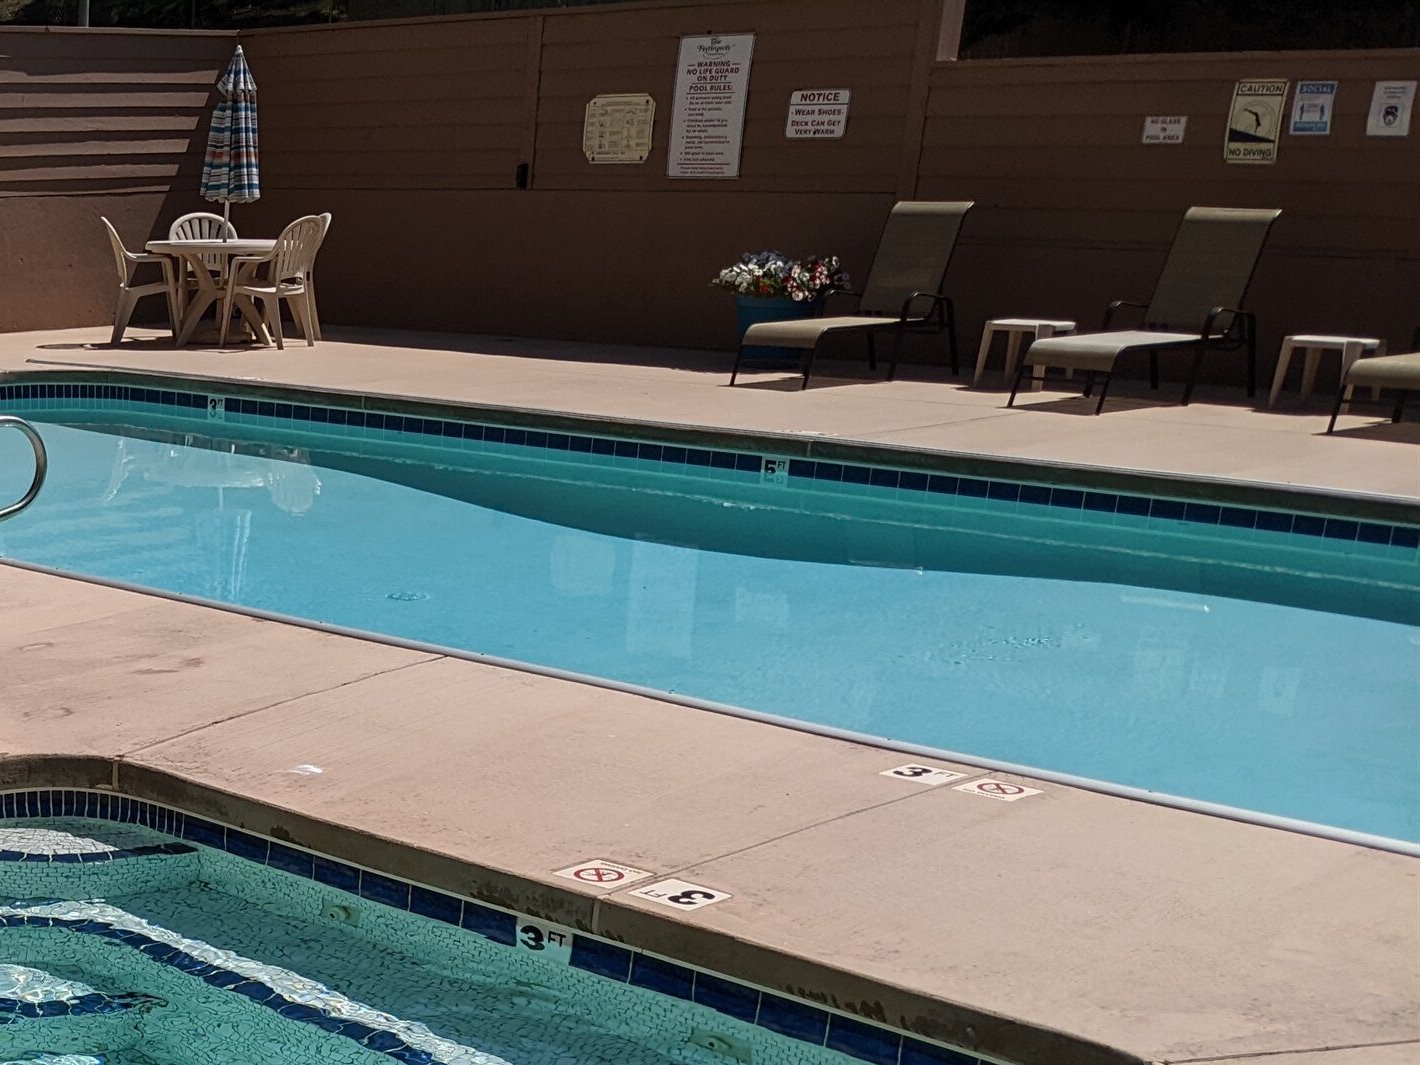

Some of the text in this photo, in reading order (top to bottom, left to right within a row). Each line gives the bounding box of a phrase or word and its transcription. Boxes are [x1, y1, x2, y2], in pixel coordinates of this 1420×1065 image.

[697, 60, 731, 68] WARNING
[1240, 84, 1284, 93] CAUTION
[800, 92, 841, 102] NOTICE
[794, 108, 842, 116] WEAR SHOES
[1243, 148, 1272, 157] DIVING
[764, 459, 777, 474] 5
[893, 767, 932, 777] 3
[668, 890, 716, 905] 3
[520, 925, 567, 951] 3 FT
